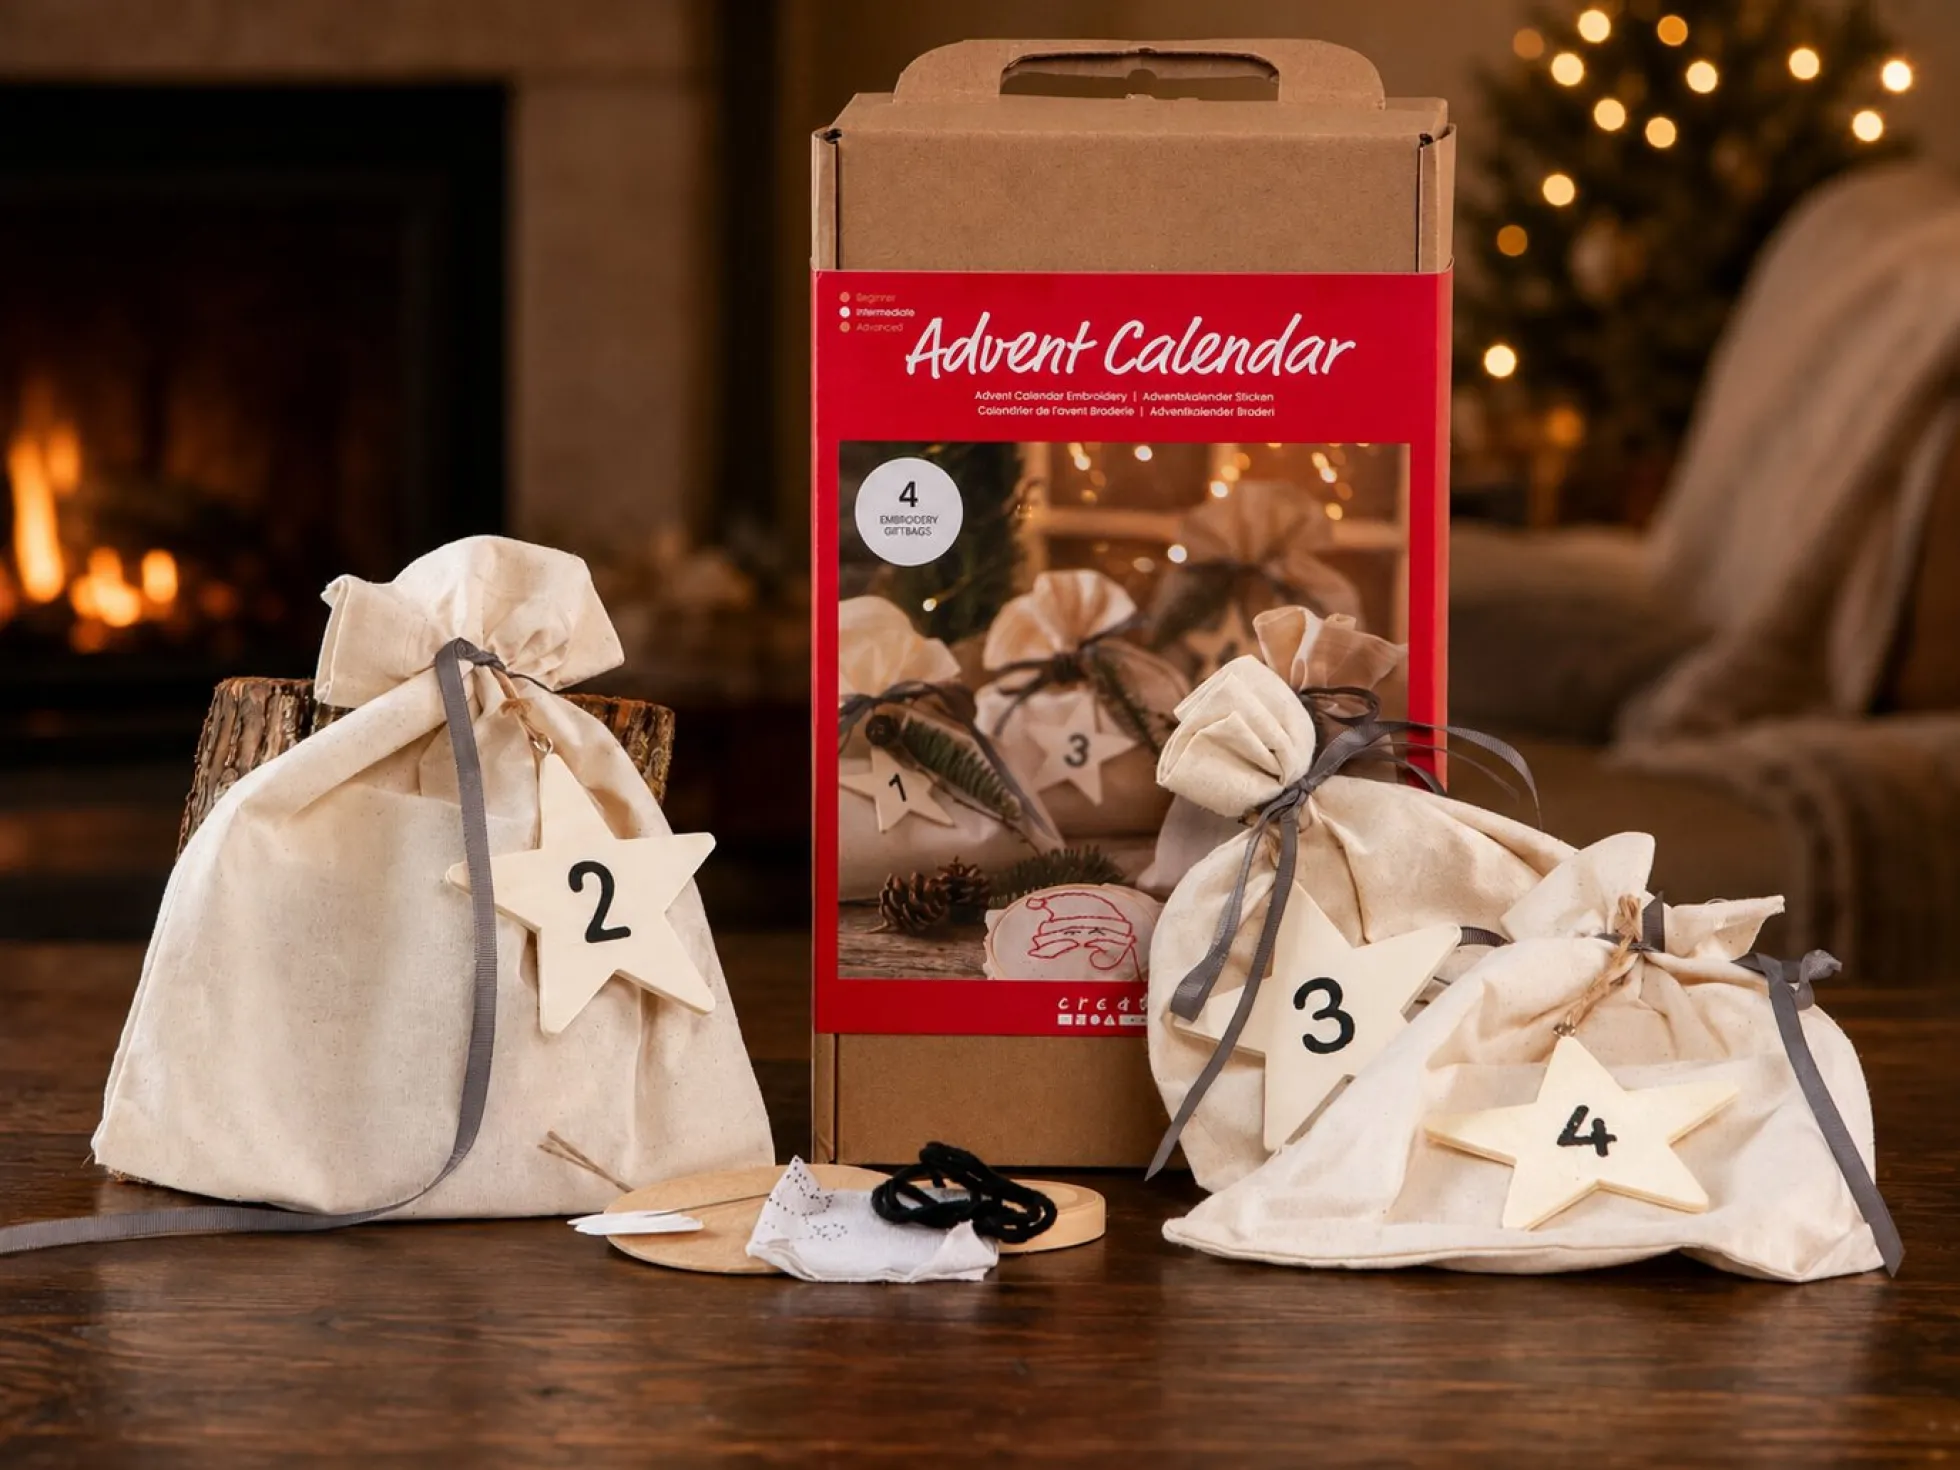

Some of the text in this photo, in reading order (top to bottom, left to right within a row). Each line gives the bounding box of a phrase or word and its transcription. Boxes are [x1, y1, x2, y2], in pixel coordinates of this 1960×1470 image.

[856, 308, 915, 317] Intermediate
[856, 323, 904, 332] Advanced
[905, 311, 1357, 380] Advent Calendar
[975, 391, 1012, 400] Advent
[1014, 391, 1064, 400] Calendar
[1066, 391, 1128, 402] Embroidery
[1235, 392, 1274, 401] Sticken
[977, 406, 1033, 416] Calendrier
[1036, 406, 1050, 416] de
[1090, 406, 1135, 416] Broderie
[1237, 407, 1275, 417] Broderi
[899, 481, 918, 508] 4
[1063, 733, 1090, 768] 3
[888, 773, 907, 802] 1
[568, 860, 631, 943] 2
[1293, 977, 1355, 1054] 3
[1557, 1104, 1618, 1158] 4
